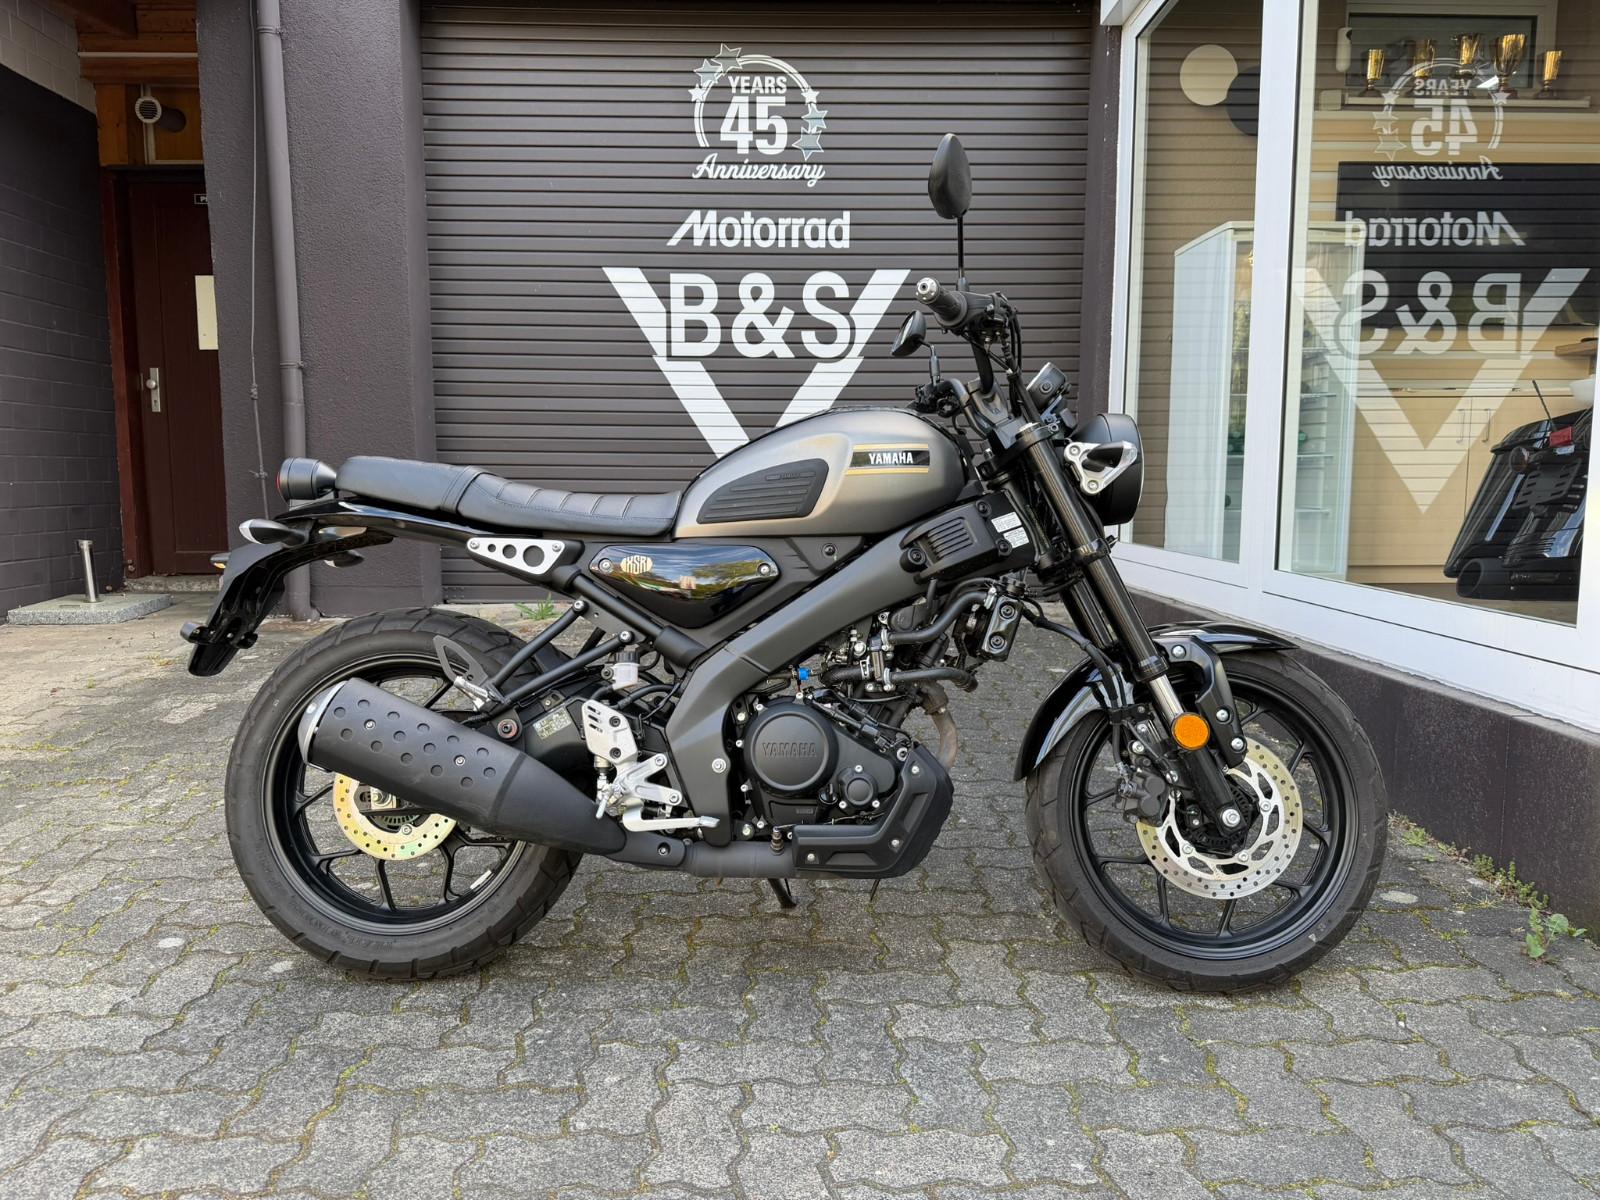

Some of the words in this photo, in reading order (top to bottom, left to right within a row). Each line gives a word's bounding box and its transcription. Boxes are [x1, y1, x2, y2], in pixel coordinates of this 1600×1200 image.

[728, 76, 787, 94] YEARS
[720, 96, 788, 155] 45
[692, 153, 826, 187] Anniversary
[666, 210, 850, 248] Motorrad
[669, 271, 850, 358] B&S
[868, 452, 914, 465] YAMAHA
[623, 555, 651, 575] XSR
[761, 742, 817, 758] YAMAHA
